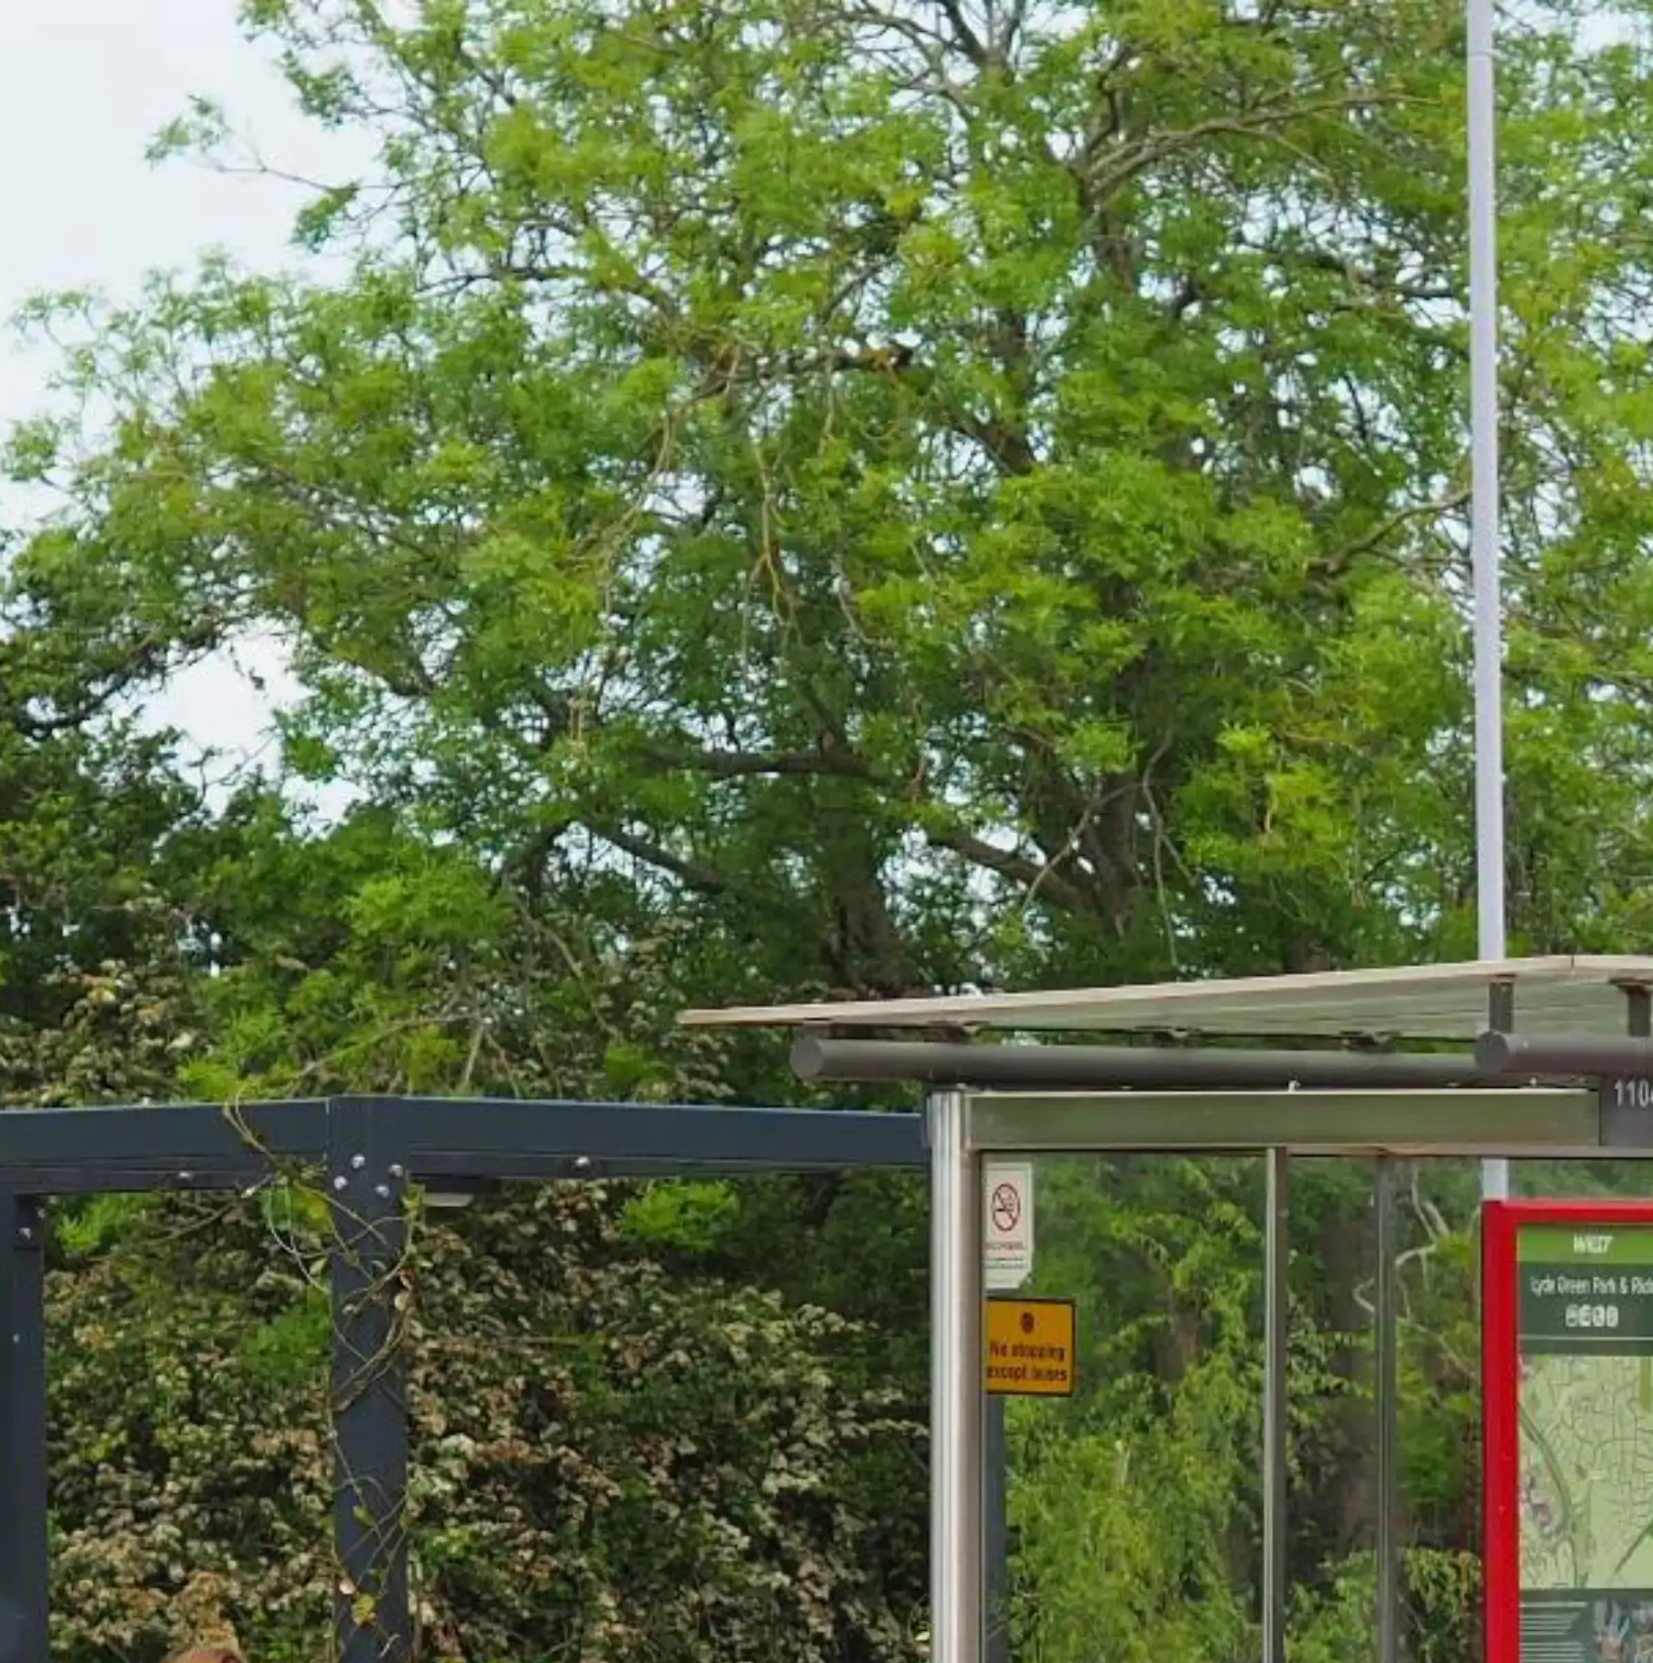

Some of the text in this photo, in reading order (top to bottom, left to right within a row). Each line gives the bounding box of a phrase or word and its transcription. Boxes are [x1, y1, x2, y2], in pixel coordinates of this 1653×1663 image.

[1557, 1275, 1590, 1296] Green
[1592, 1275, 1617, 1295] Park
[989, 1339, 1067, 1363] No stopping
[987, 1364, 1027, 1385] except
